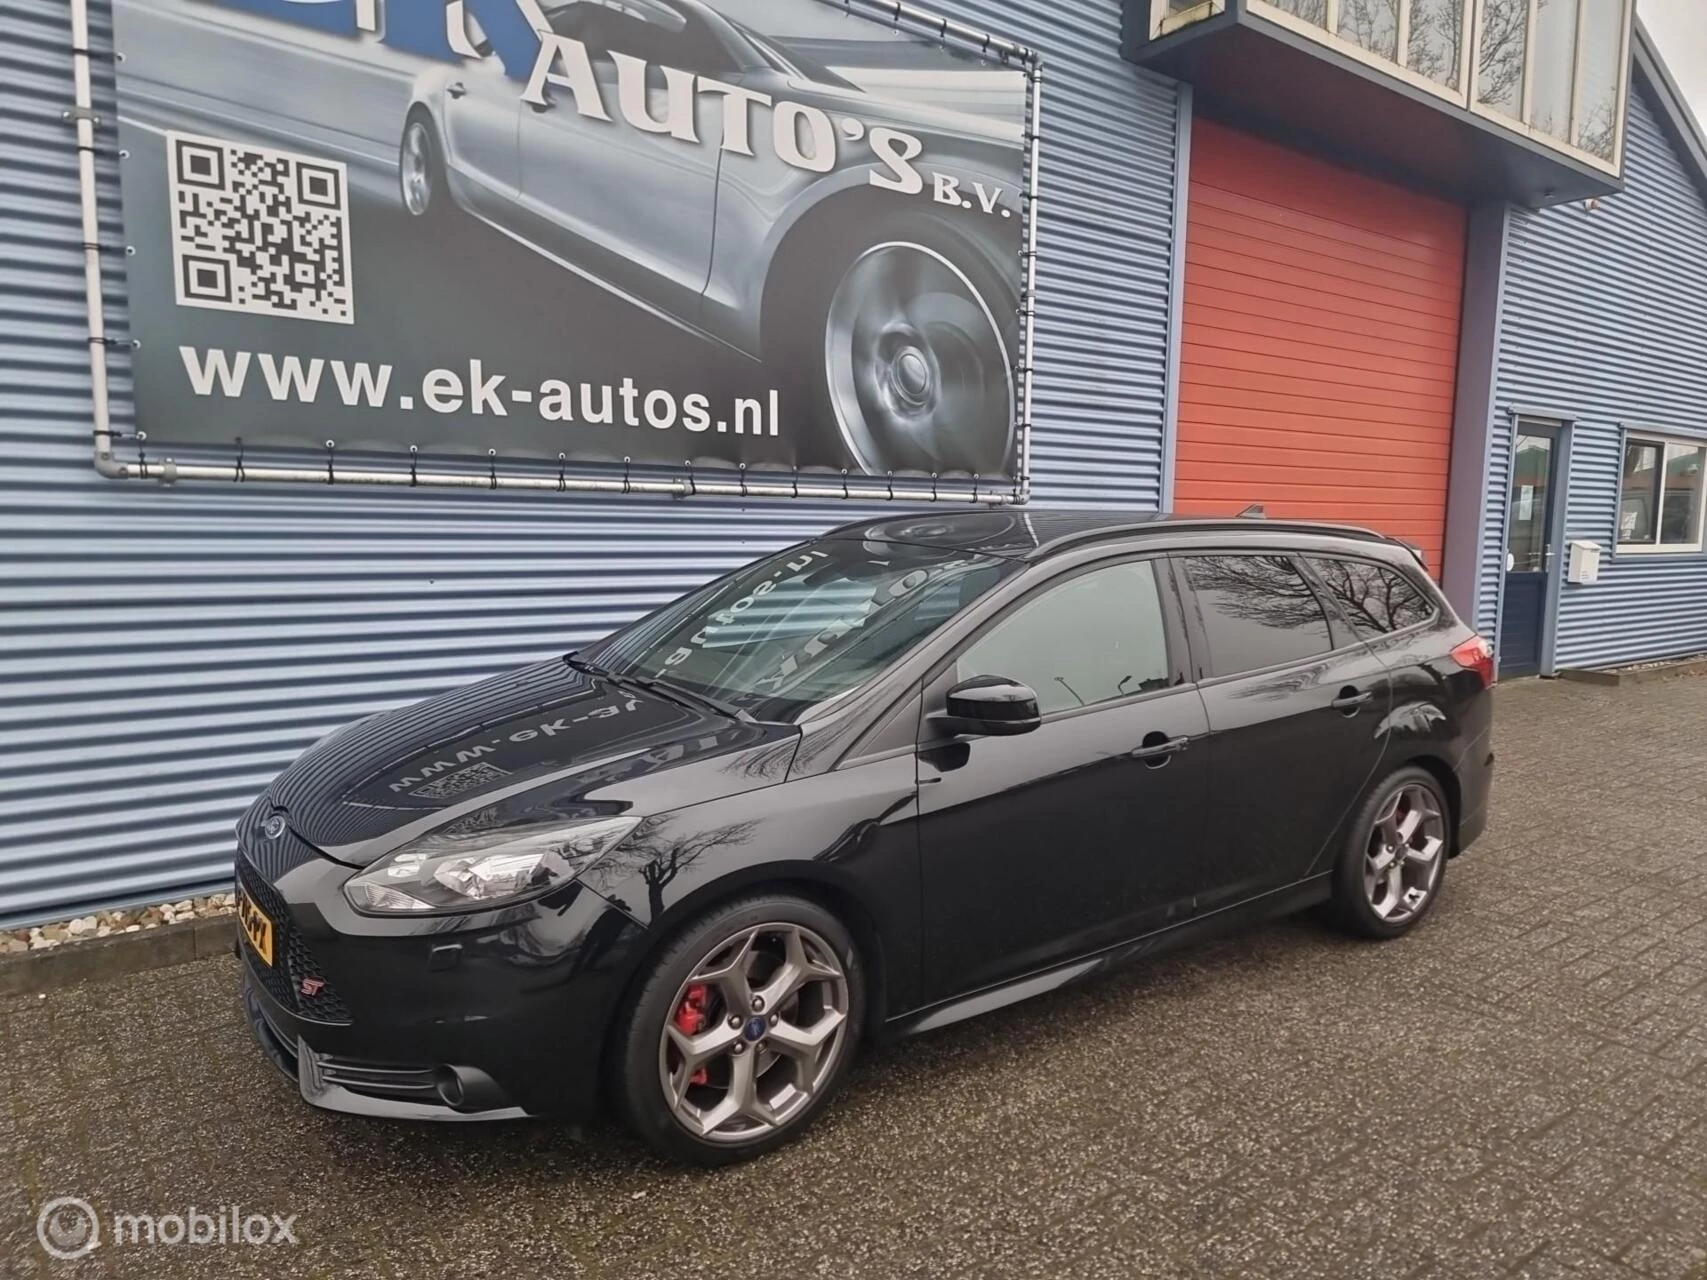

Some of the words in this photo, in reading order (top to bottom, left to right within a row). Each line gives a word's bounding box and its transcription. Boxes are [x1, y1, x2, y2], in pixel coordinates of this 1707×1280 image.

[932, 171, 1012, 219] B.V.
[178, 344, 780, 437] www.ek-autos.nl
[301, 978, 326, 997] ST
